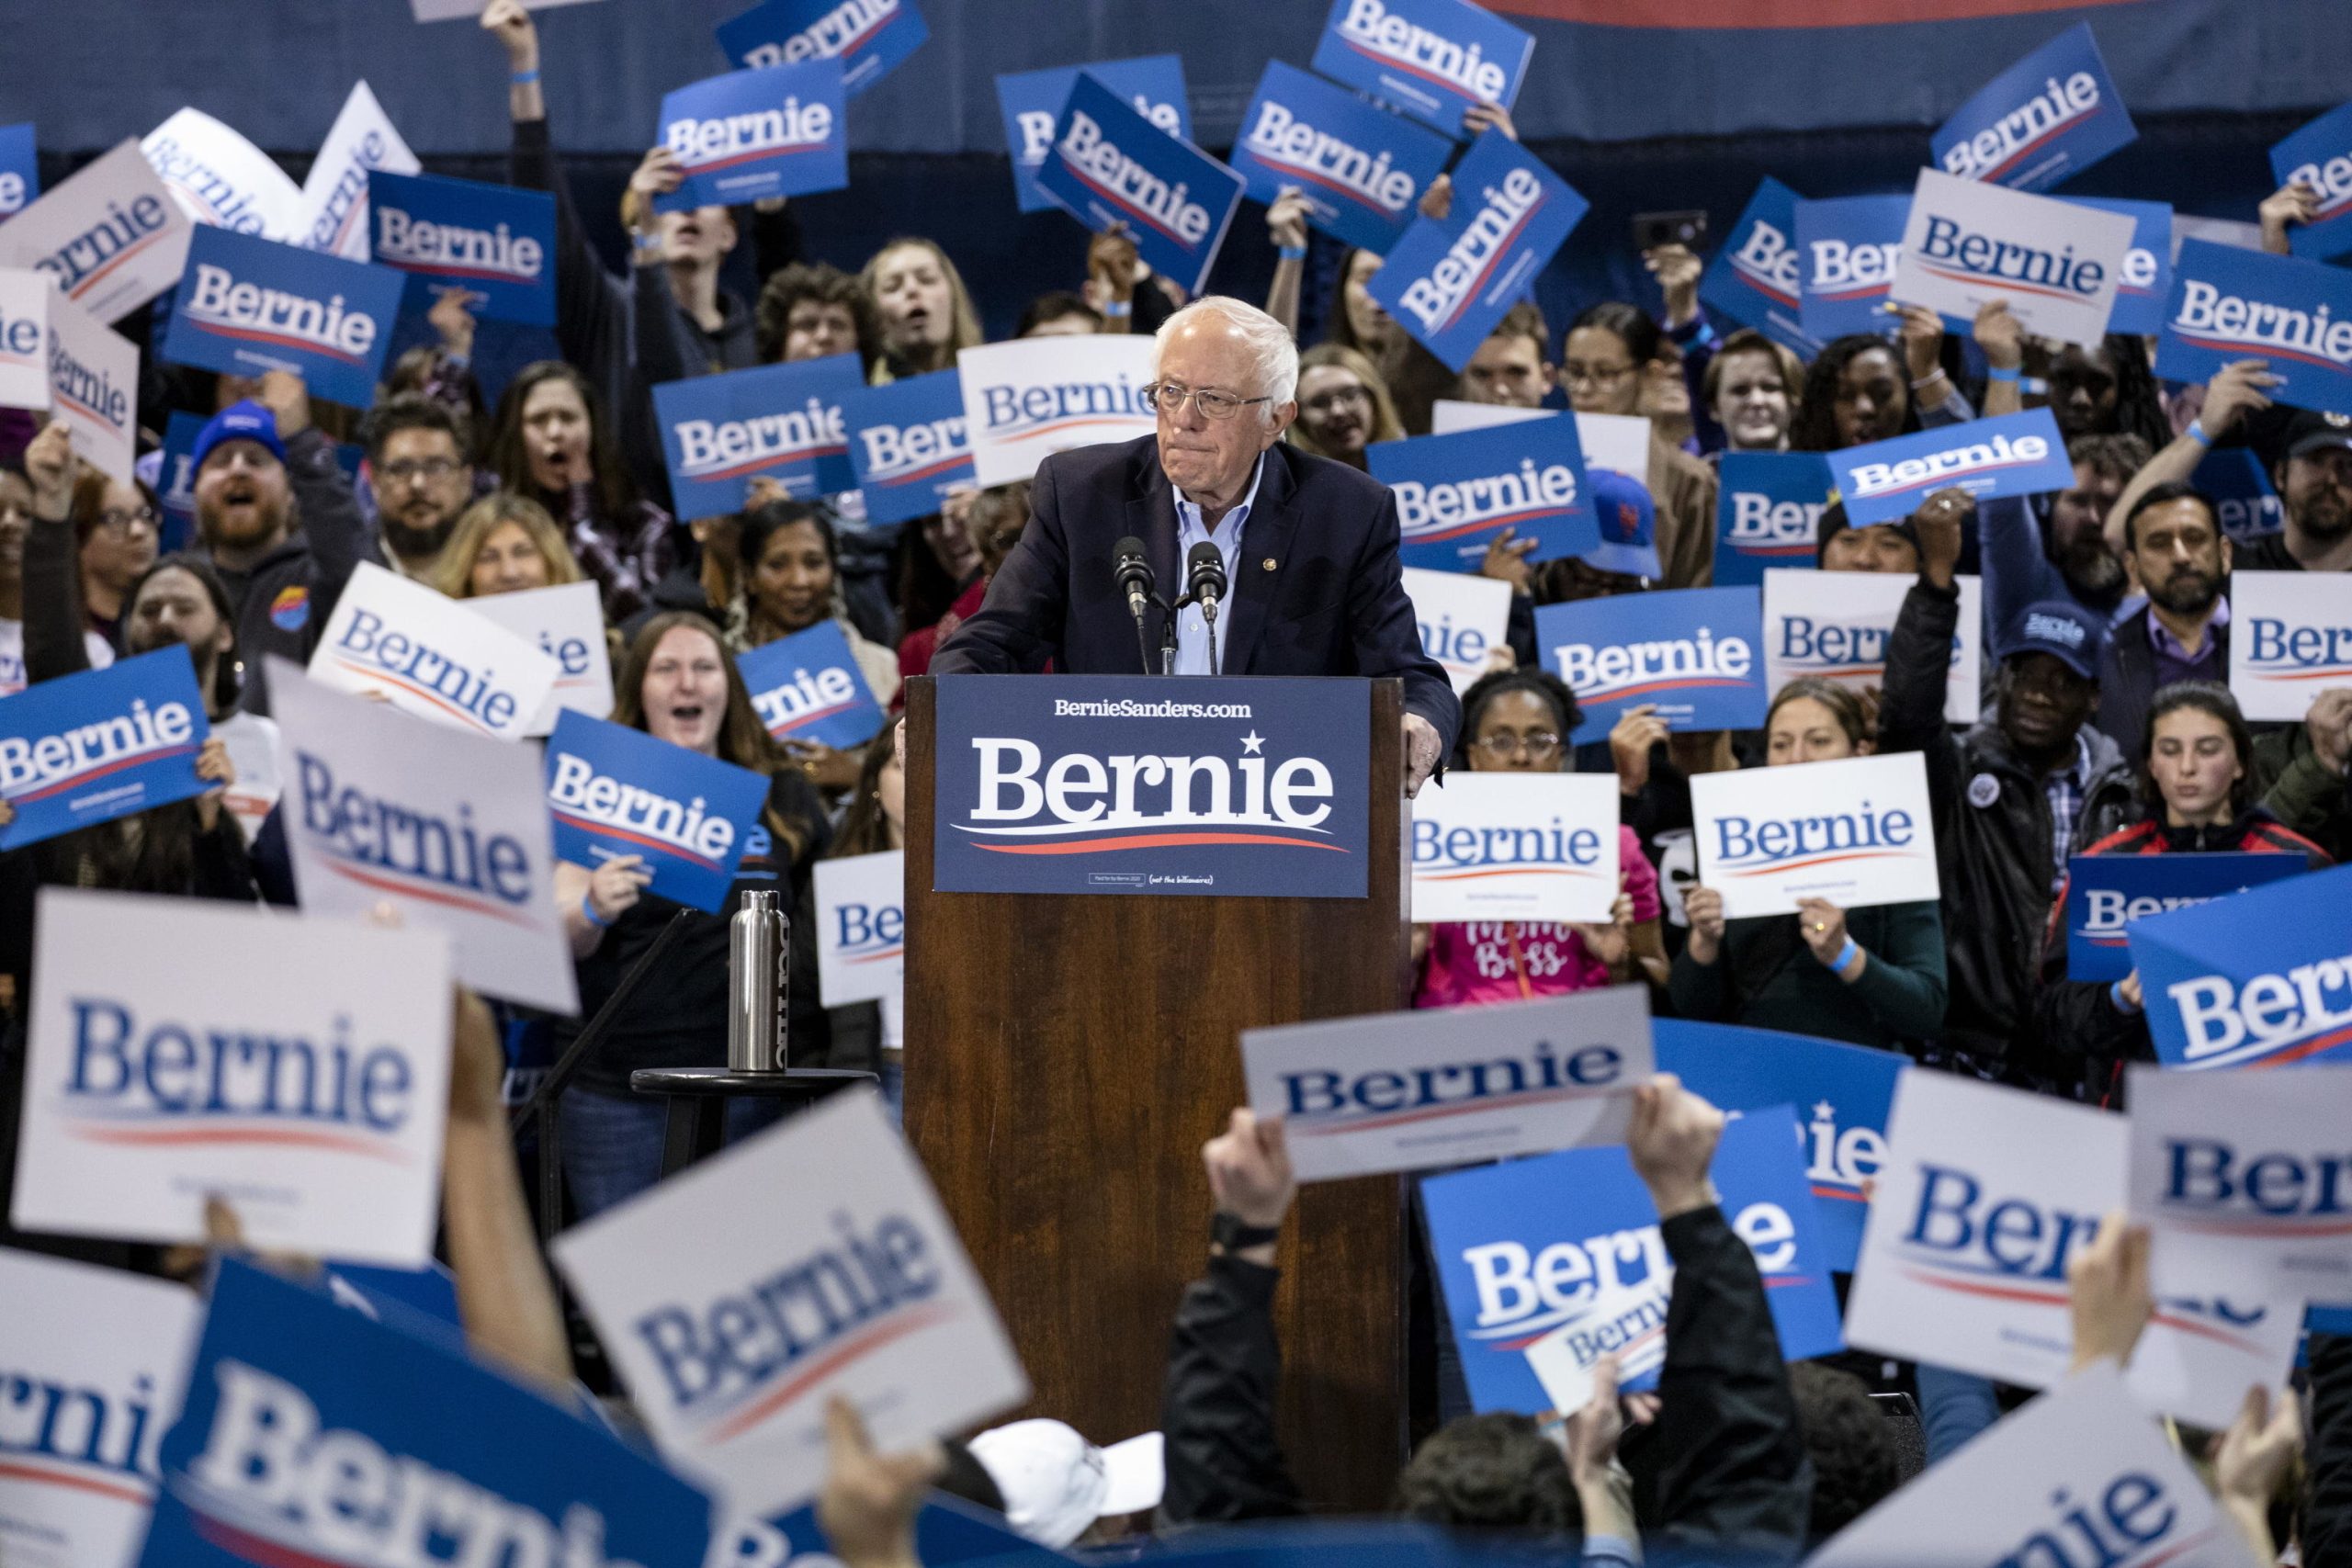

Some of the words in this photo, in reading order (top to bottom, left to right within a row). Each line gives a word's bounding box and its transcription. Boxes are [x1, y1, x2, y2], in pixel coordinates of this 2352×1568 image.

[742, 0, 901, 70] Berni
[1341, 0, 1507, 101] Bernie
[666, 96, 832, 158] Bernie
[1250, 100, 1417, 212] Bernie
[1943, 72, 2100, 177] Bernie
[145, 136, 266, 237] Bernie
[292, 129, 387, 252] ernie
[1061, 110, 1211, 244] Bernie
[35, 193, 167, 293] rnie
[377, 206, 544, 277] Bernie
[1399, 168, 1543, 327] Bernie
[1918, 214, 2105, 297] Bernie
[188, 264, 377, 355] Bernie
[2176, 278, 2352, 364] Bernie
[859, 414, 971, 473] Ber
[1849, 434, 2049, 496] Bernie
[1389, 457, 1577, 533] Bernie
[1731, 491, 1826, 540] Ber
[339, 607, 517, 731] Bernie
[1555, 626, 1751, 691] Bernie
[2249, 617, 2352, 665] Ber
[750, 667, 855, 729] rnie
[1055, 699, 1252, 718] BernieSanders.com
[0, 698, 192, 787] Bernie
[970, 728, 1334, 828] Bernie
[296, 748, 535, 907] Bernie
[549, 752, 735, 861] Bernie
[1412, 817, 1600, 868] Bernie
[1713, 800, 1915, 863] Bernie
[2166, 953, 2352, 1060] Ber
[66, 994, 414, 1134] Bernie
[1277, 1042, 1624, 1118] Bernie
[2159, 1135, 2352, 1216] Ber
[634, 1207, 941, 1408] Bernie
